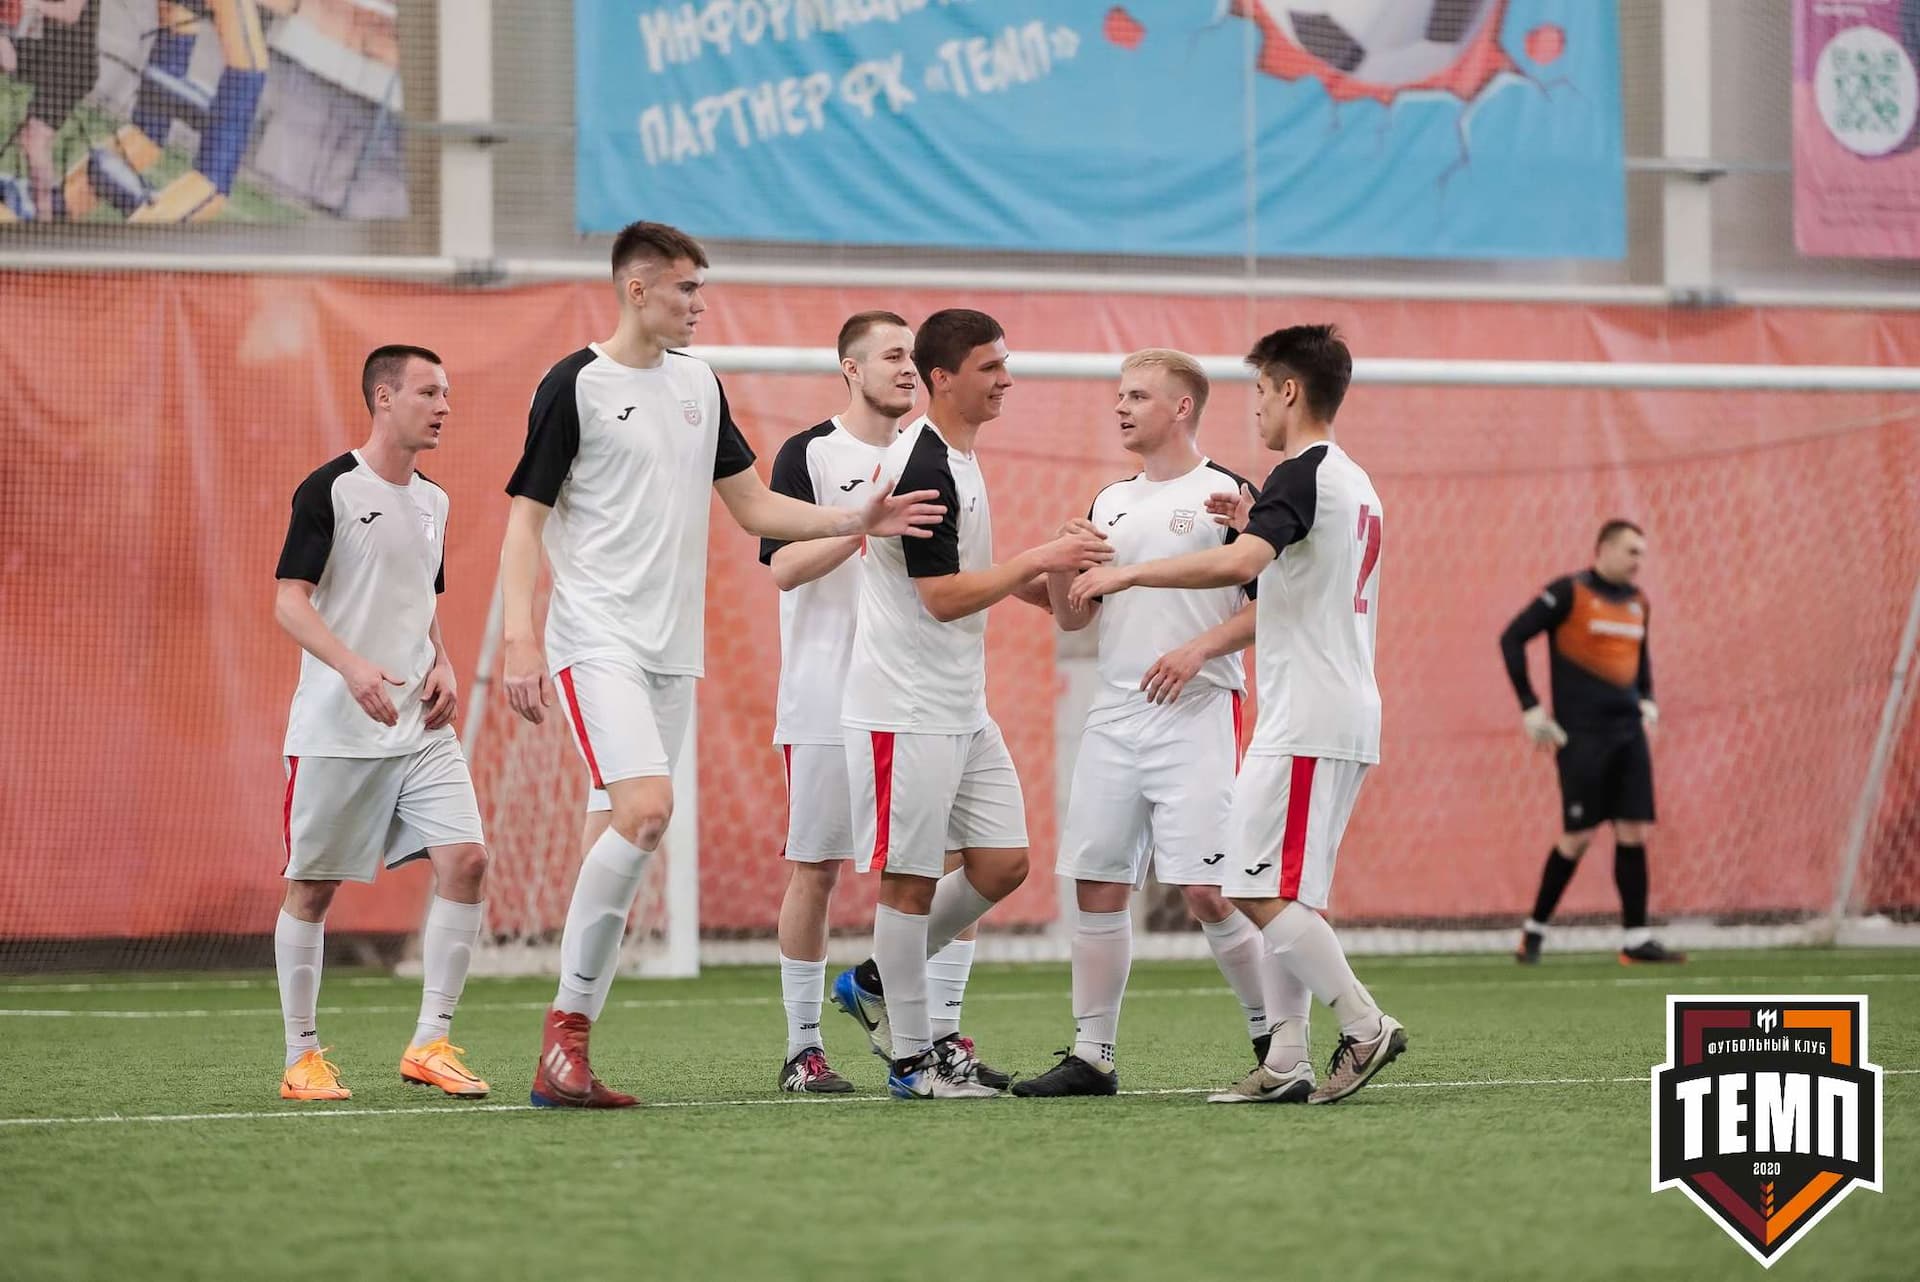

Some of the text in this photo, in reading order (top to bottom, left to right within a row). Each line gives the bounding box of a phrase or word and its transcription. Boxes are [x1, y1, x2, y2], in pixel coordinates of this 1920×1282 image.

[639, 71, 832, 166] ПАРТНЕР
[840, 52, 917, 118] ФК
[1353, 504, 1381, 614] 2
